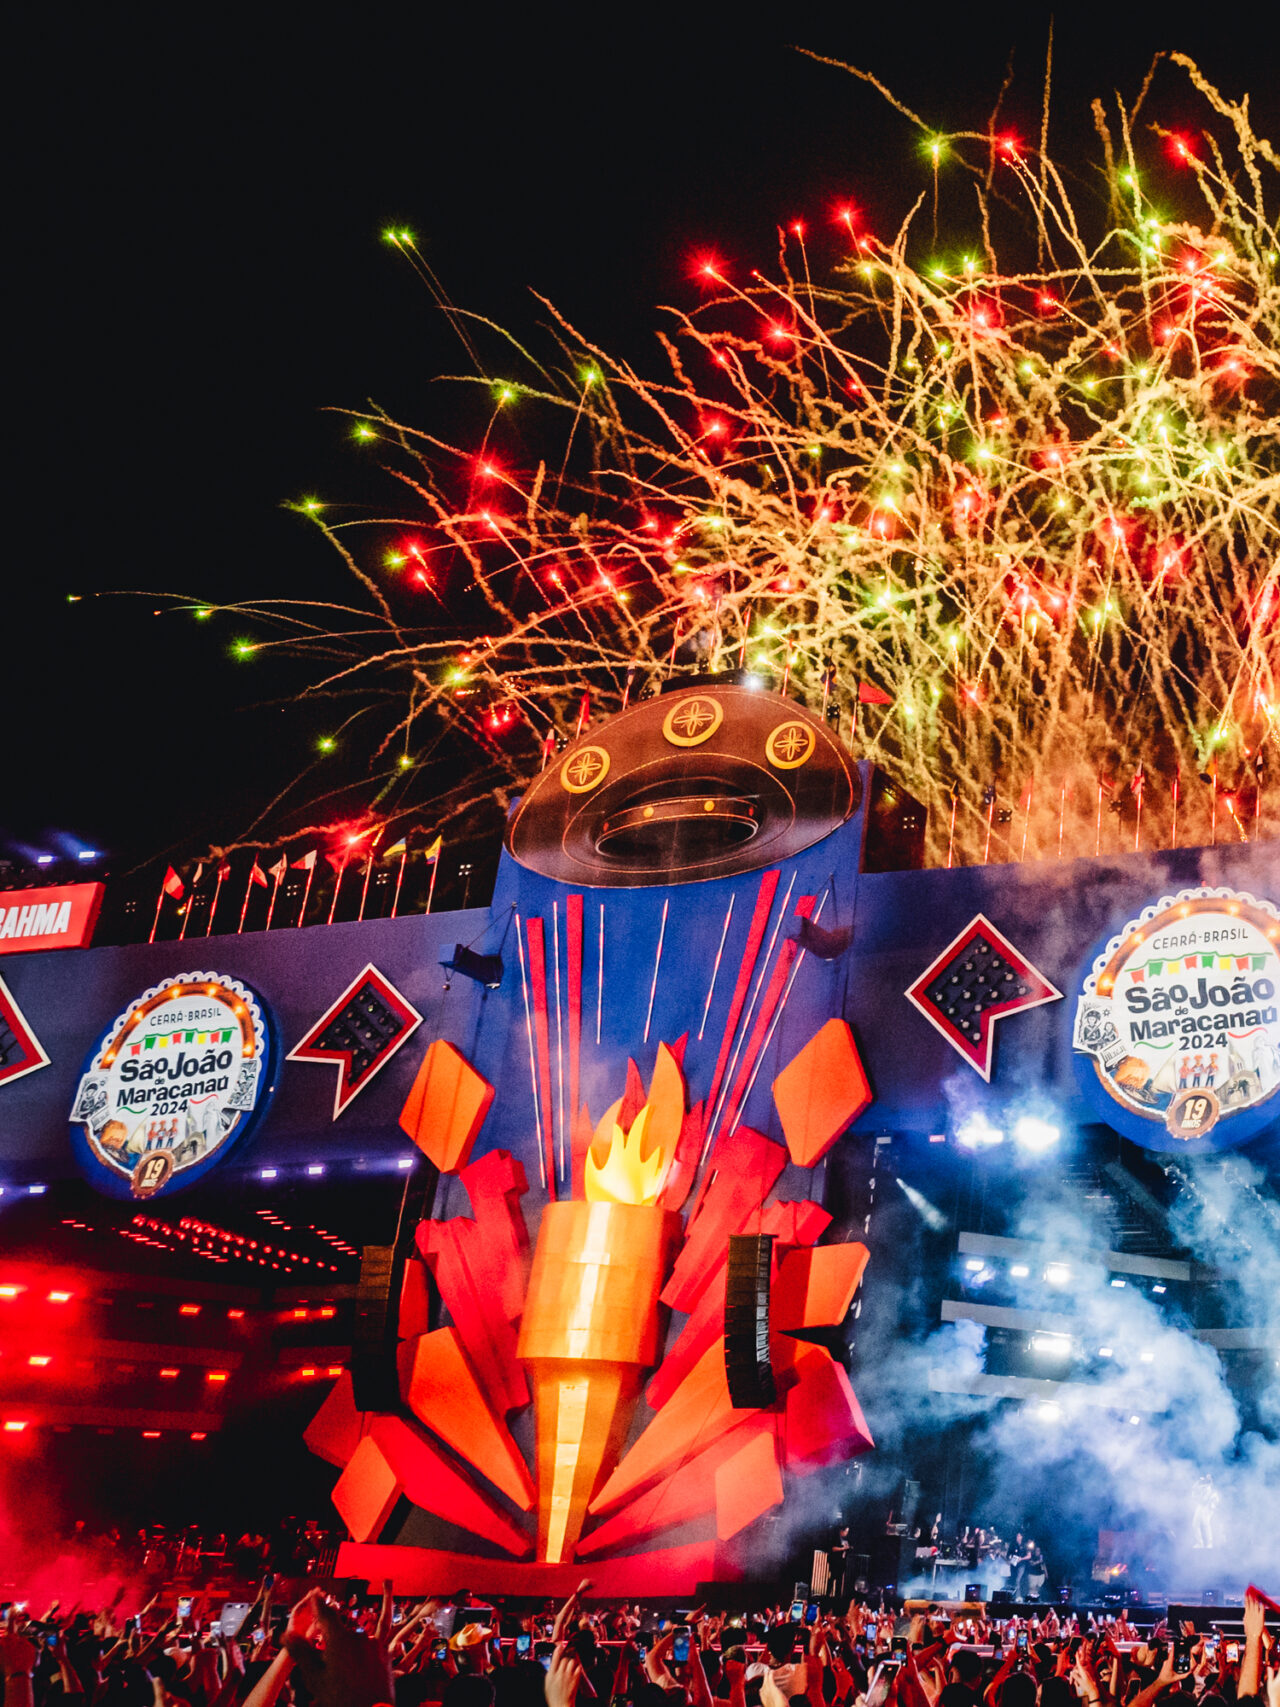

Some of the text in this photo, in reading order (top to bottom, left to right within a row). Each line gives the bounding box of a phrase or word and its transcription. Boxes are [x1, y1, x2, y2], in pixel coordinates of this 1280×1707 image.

[1125, 976, 1275, 1014] São João
[1175, 1006, 1188, 1016] de
[1130, 1006, 1277, 1042] Maracanaú
[1179, 1032, 1228, 1050] 2024
[120, 1049, 233, 1082] São João
[117, 1075, 229, 1107] Maracanaú
[155, 1077, 165, 1085] de
[150, 1099, 188, 1116] 2024
[1184, 1099, 1207, 1120] 19
[145, 1159, 165, 1180] 19
